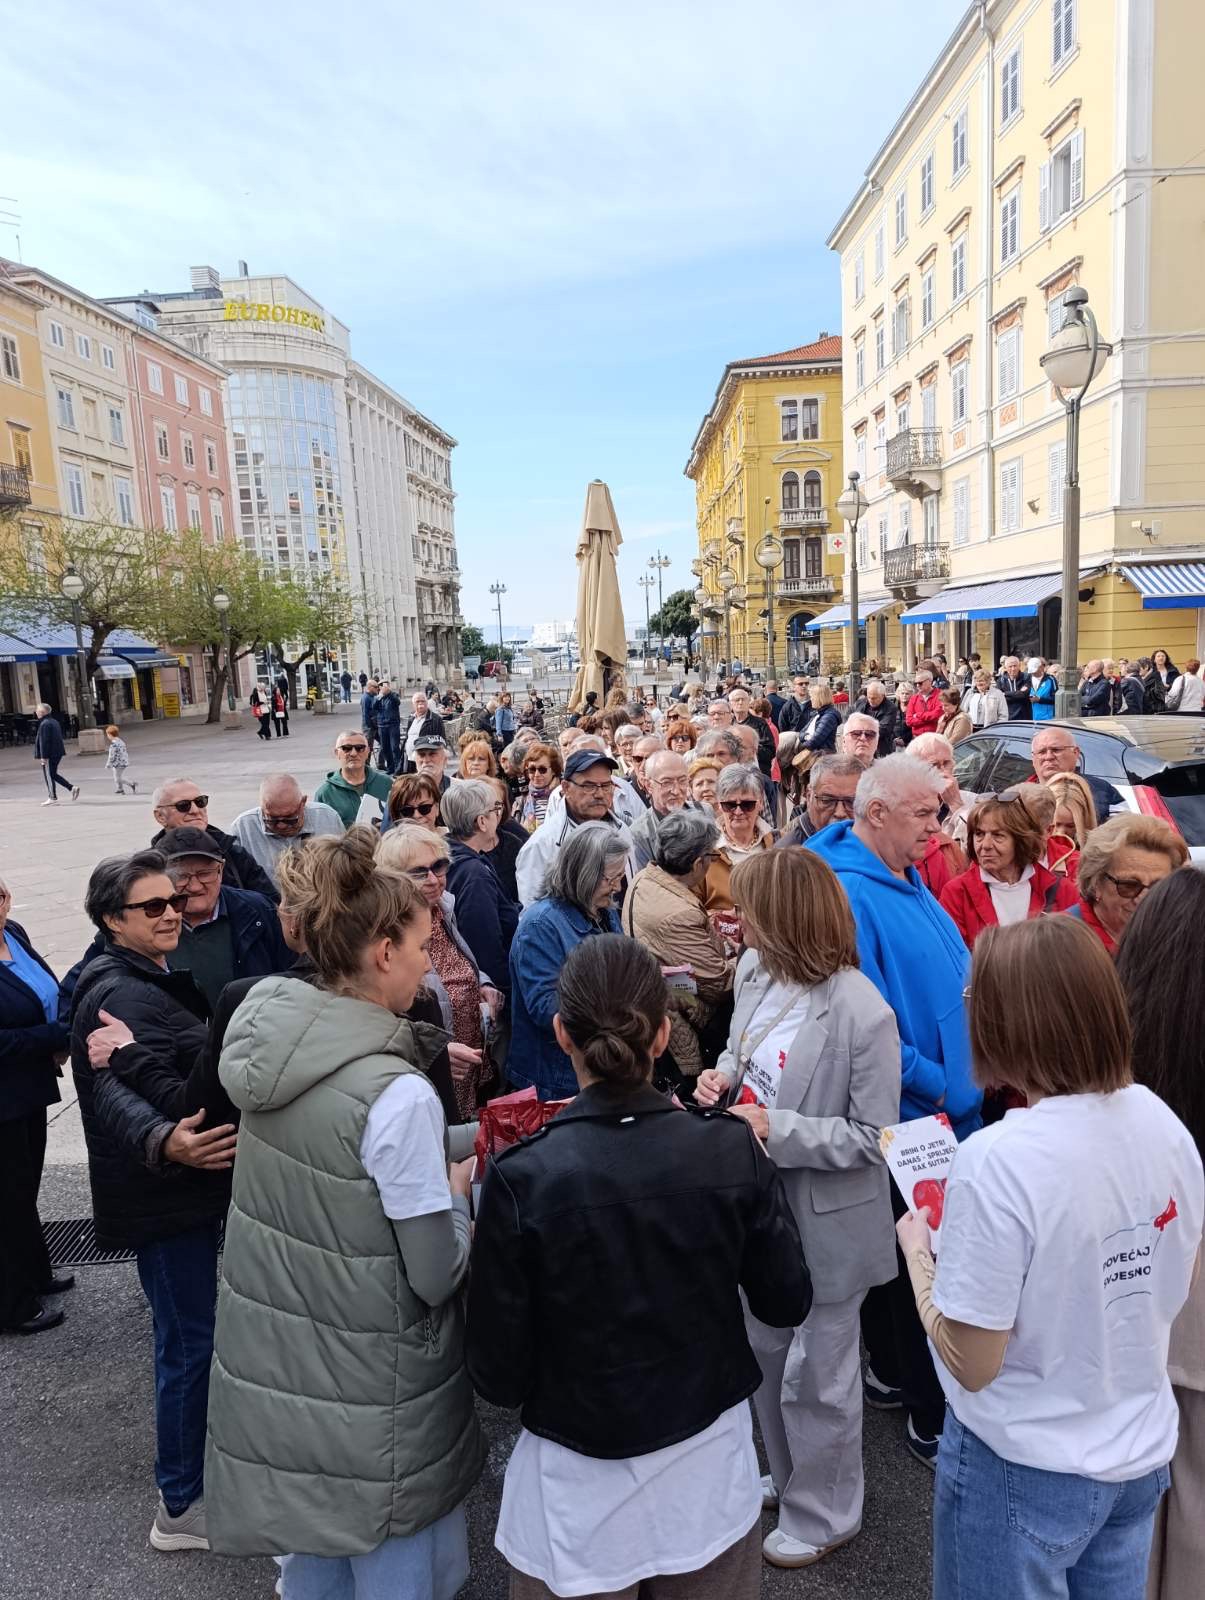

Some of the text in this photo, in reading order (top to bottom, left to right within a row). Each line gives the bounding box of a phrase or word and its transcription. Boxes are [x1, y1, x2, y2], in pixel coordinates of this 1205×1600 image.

[900, 1139, 946, 1157] BRINI O JETRI
[897, 1155, 921, 1168] DANAS
[912, 1157, 950, 1172] RAK SUTRA
